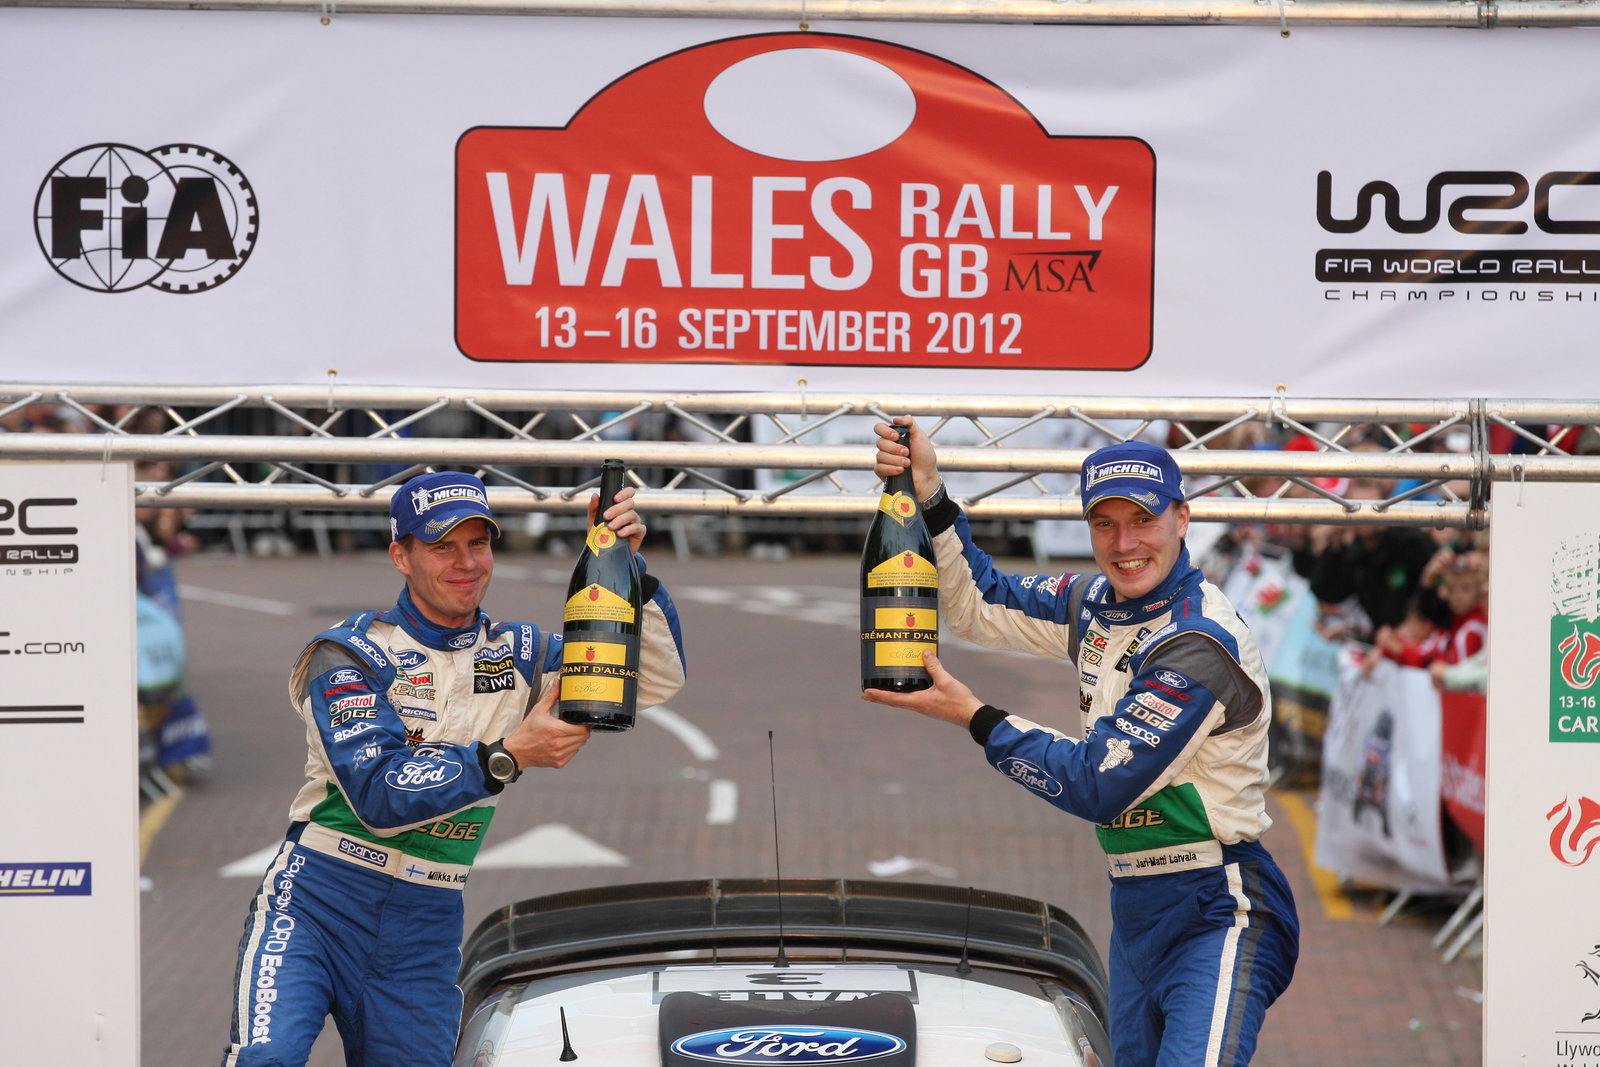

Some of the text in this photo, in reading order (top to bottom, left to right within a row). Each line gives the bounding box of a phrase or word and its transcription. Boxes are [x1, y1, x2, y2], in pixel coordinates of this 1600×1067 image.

[900, 182, 1120, 241] RALLY
[486, 172, 873, 291] WALES
[899, 243, 989, 299] GB
[1002, 250, 1103, 293] MSA
[1325, 258, 1600, 274] FIA WORLD RALL
[1325, 290, 1597, 302] CHAMPIONSHI
[678, 307, 911, 353] SEPTEMBER
[926, 312, 1022, 354] 2012
[1098, 463, 1158, 478] MICHELIN
[6, 549, 74, 560] RALLY
[346, 635, 388, 669] sparco
[520, 624, 533, 662] sparco
[334, 671, 358, 683] Ford
[490, 674, 514, 690] IWS
[1160, 671, 1182, 686] Ford
[338, 695, 374, 711] Castrol
[1142, 694, 1178, 718] Castrol
[1559, 696, 1597, 708] 13-16
[330, 709, 378, 729] EDGE
[1124, 702, 1177, 732] EDGE
[333, 721, 385, 743] spar
[1115, 717, 1161, 748] sparco
[396, 761, 445, 786] Ford
[1010, 759, 1049, 790] Ford
[339, 839, 387, 867] sparco
[1169, 852, 1197, 864] Latvala
[745, 972, 825, 985] 3
[715, 1031, 862, 1058] Ford
